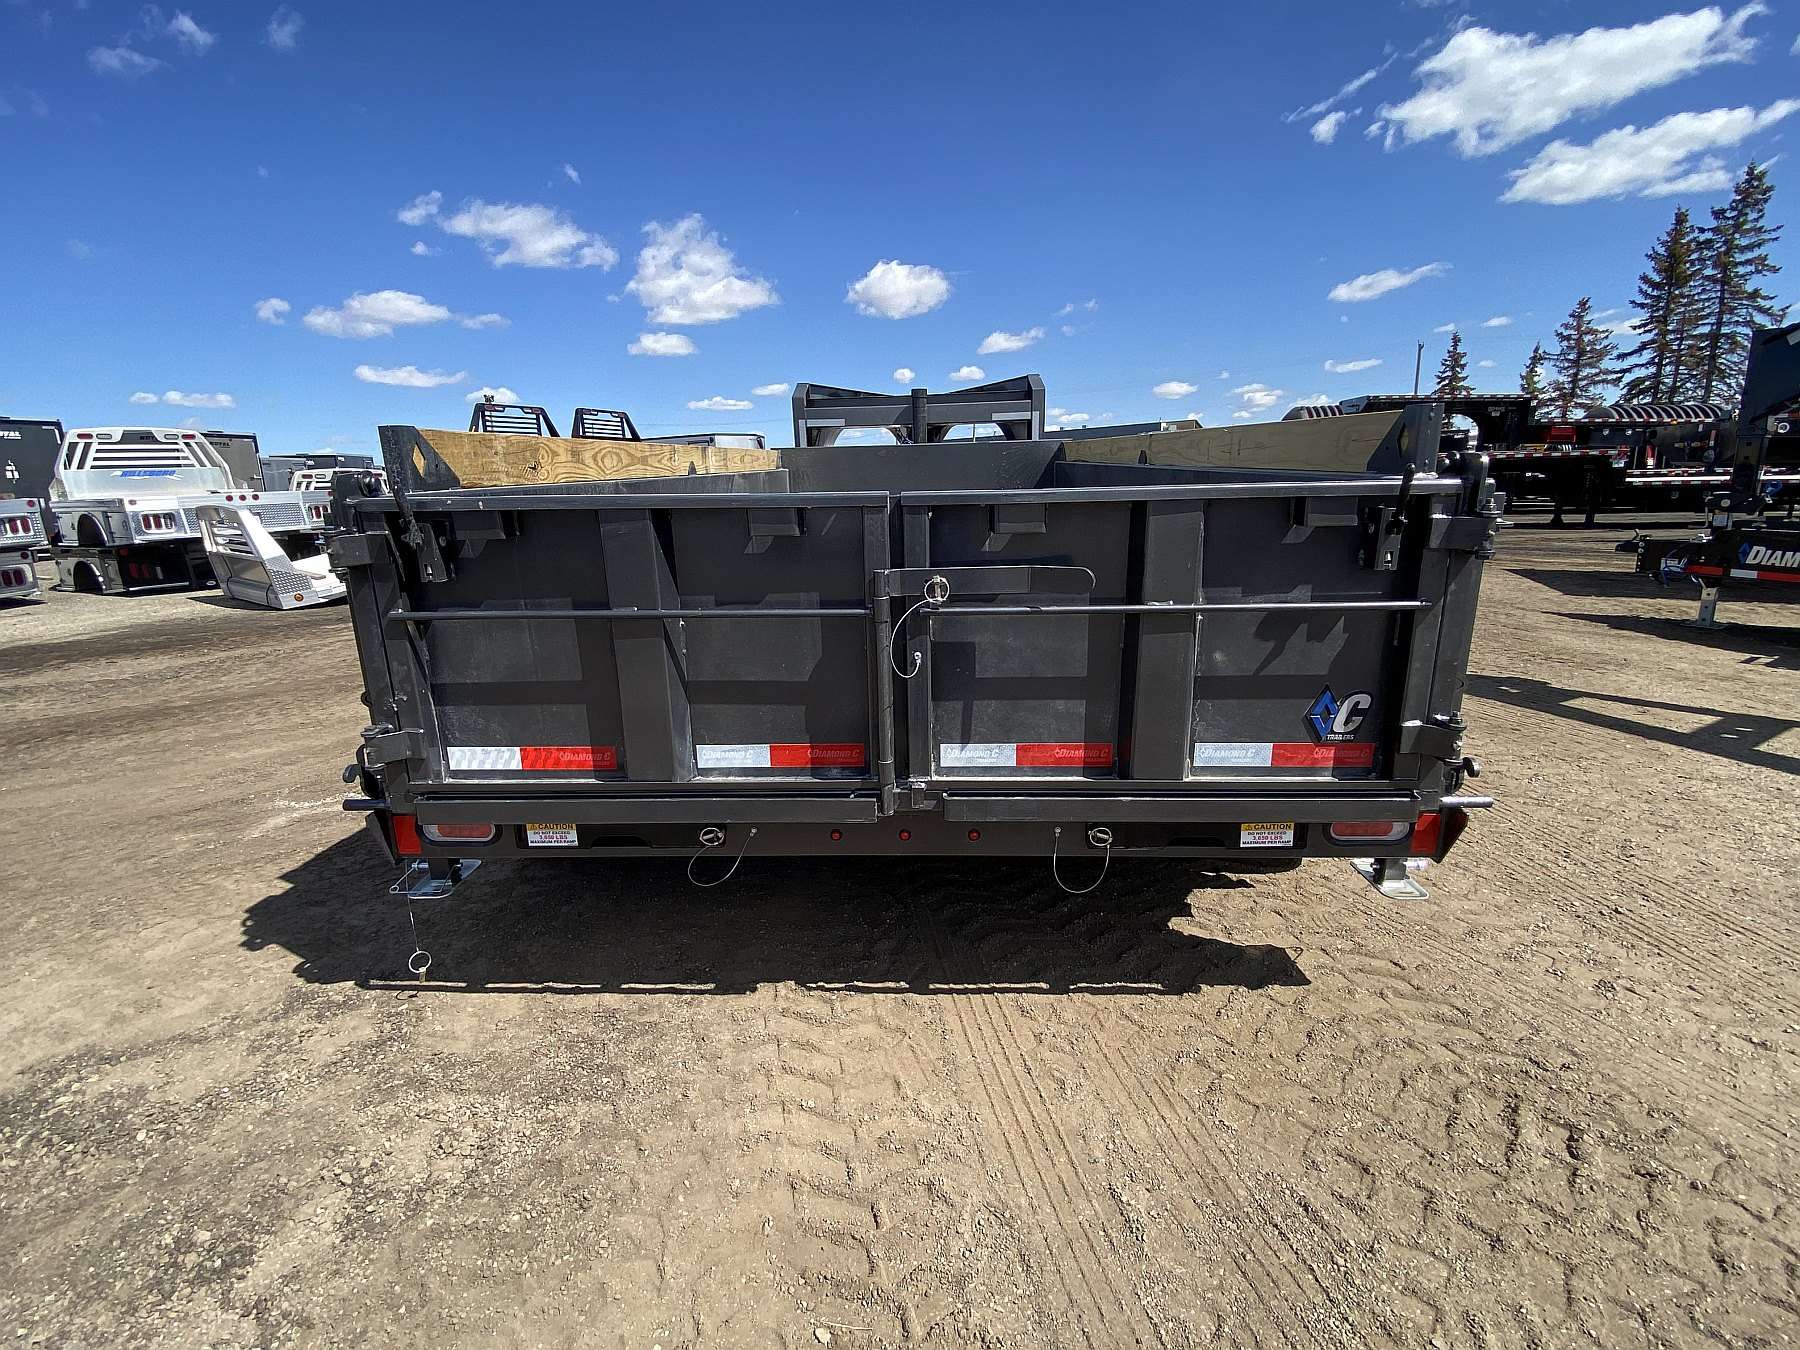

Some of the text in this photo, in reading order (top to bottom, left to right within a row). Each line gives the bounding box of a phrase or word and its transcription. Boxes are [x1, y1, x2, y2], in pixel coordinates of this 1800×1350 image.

[1333, 693, 1372, 733] C
[813, 750, 851, 758] DIAMOND
[951, 749, 990, 758] DIAMOND
